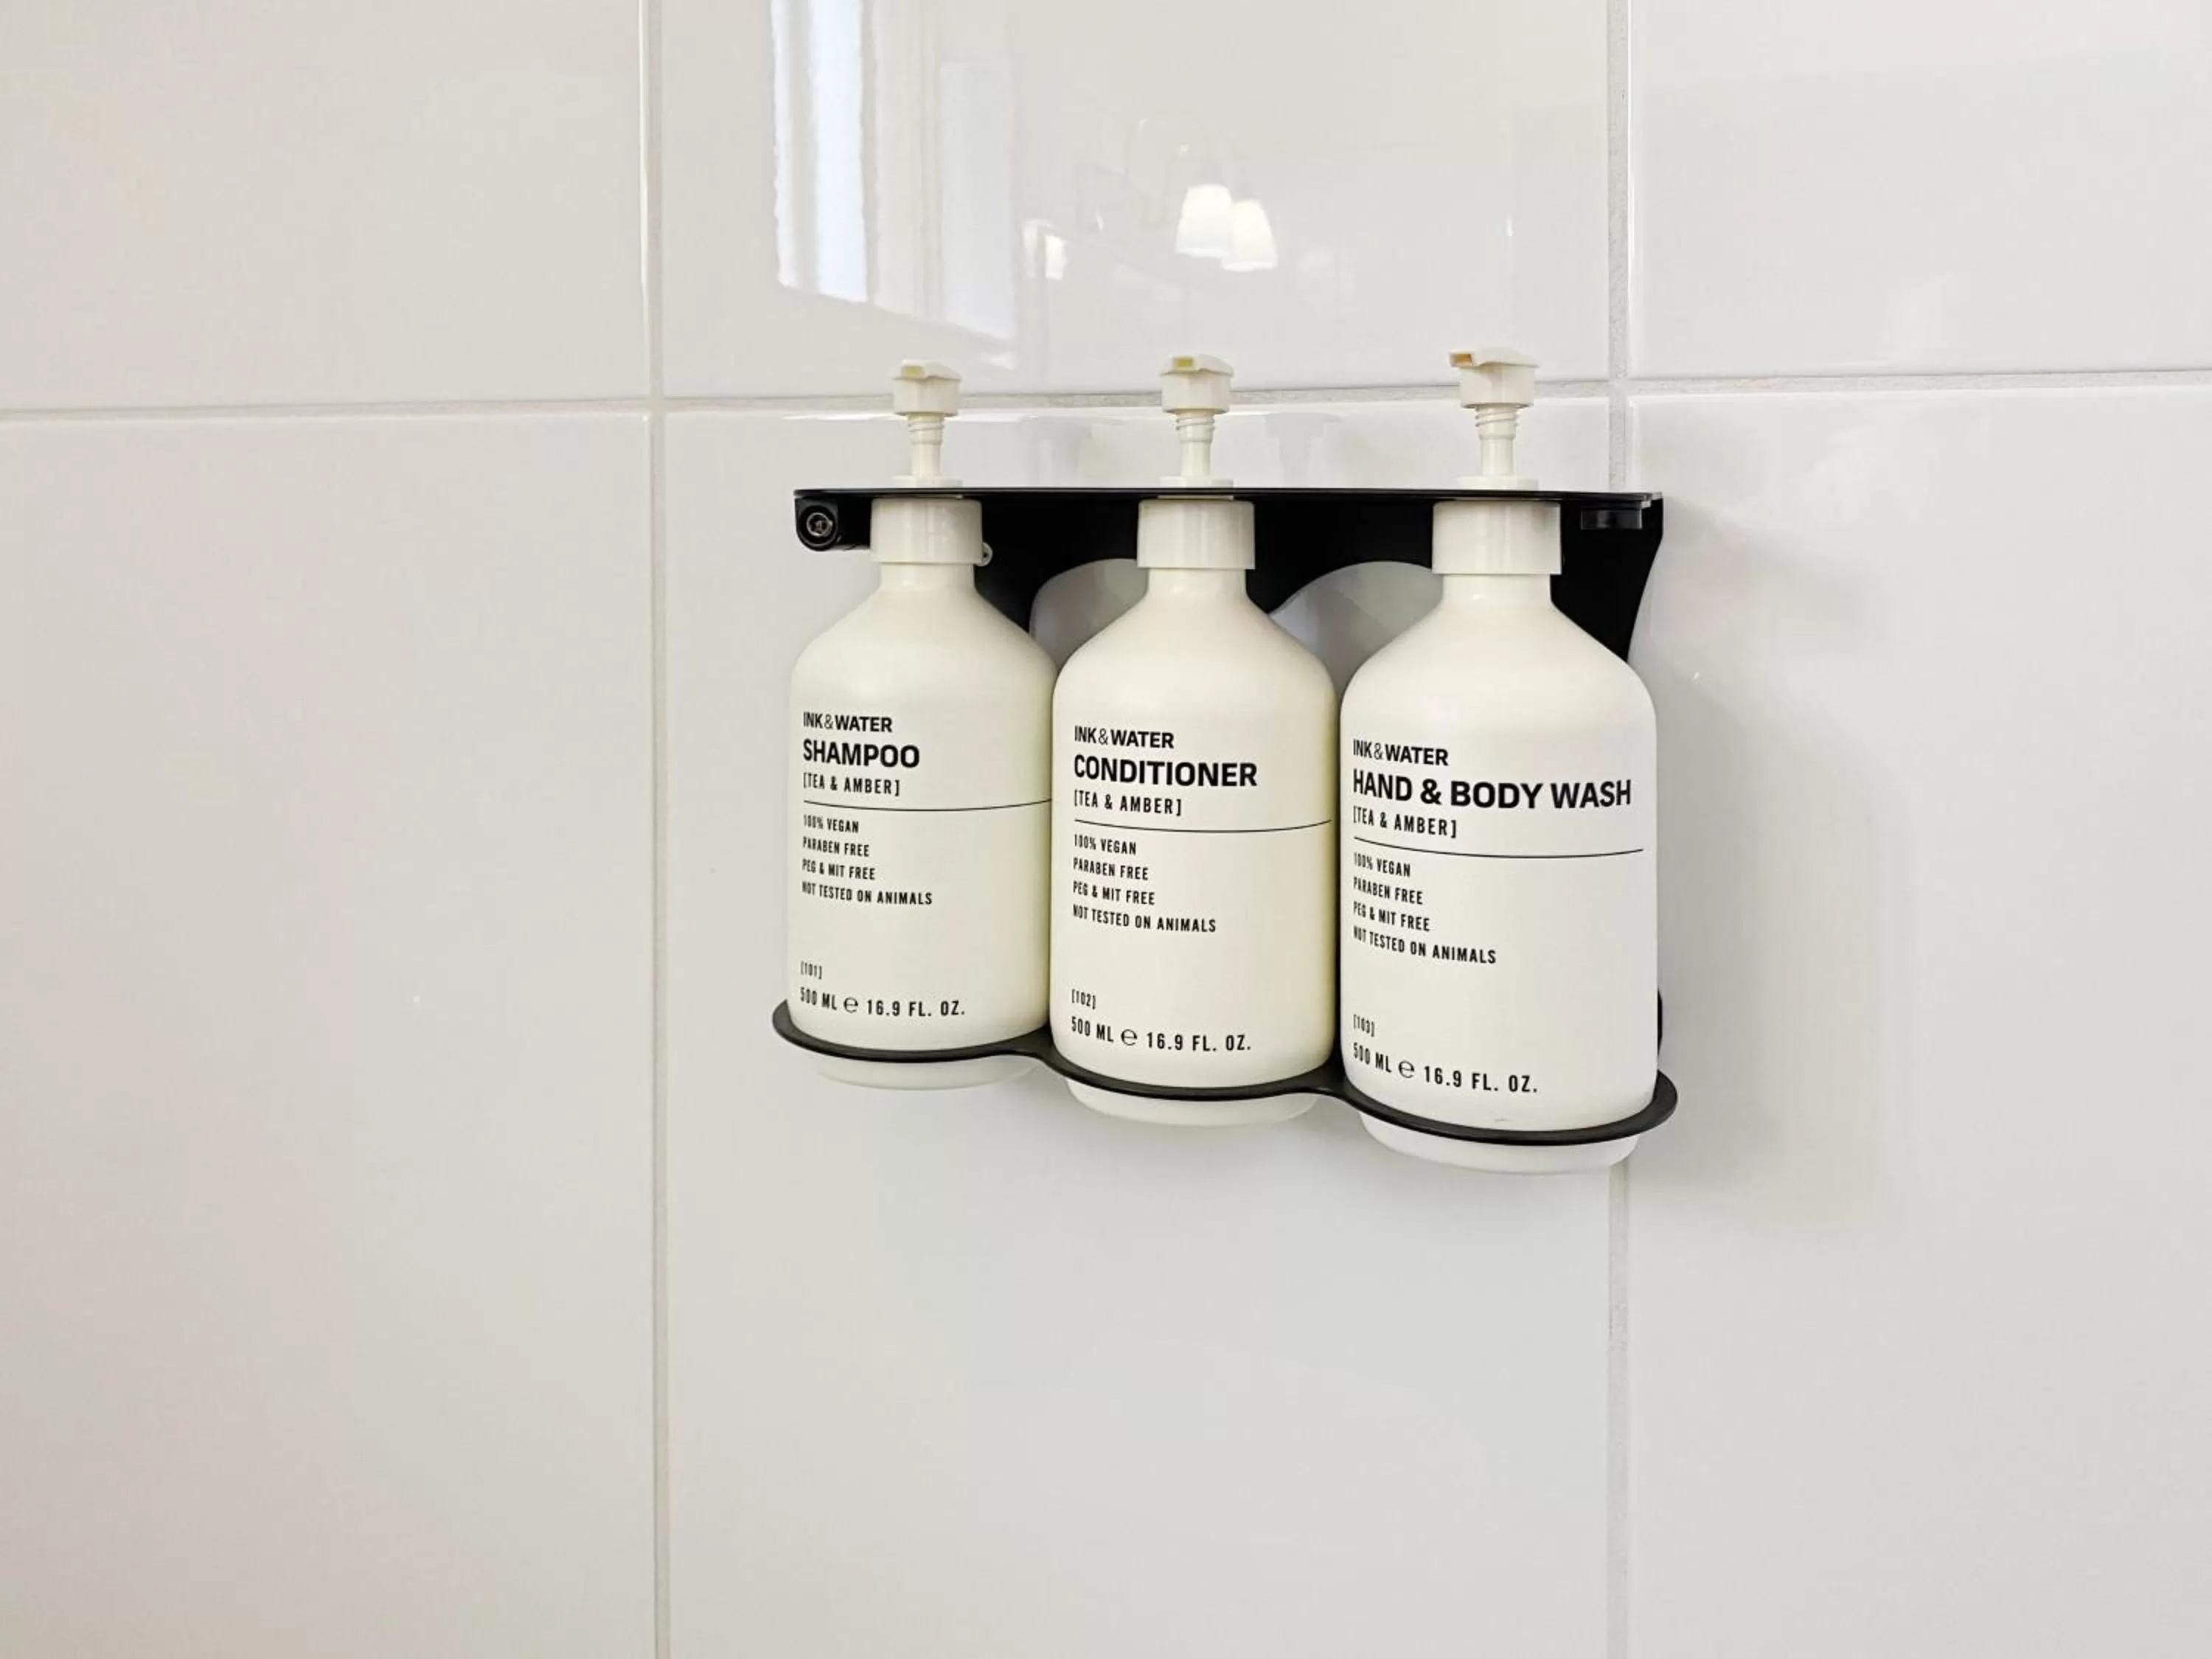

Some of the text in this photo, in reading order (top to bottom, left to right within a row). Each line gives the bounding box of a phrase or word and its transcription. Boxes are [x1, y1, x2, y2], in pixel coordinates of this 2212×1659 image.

[802, 711, 894, 734] INK&WATER
[1074, 725, 1175, 750] INK&WATER
[802, 738, 919, 768] SHAMPOO
[1352, 738, 1450, 767] INK&WATER
[1074, 754, 1258, 787] CONDITIONER
[803, 772, 901, 798] [TEA & AMBER]
[1352, 768, 1632, 810] HAND & BODY WASH
[1074, 788, 1182, 818] [TEA & AMBER]
[803, 813, 860, 834] 100% VEGAN
[1352, 804, 1457, 838] [TEA & AMBER]
[802, 835, 870, 858] PARABEN FREE
[1074, 832, 1137, 856] 100% VEGAN
[801, 858, 877, 881] PEG & MIT FREE
[1073, 857, 1150, 882] PARABEN FREE
[1353, 852, 1411, 878] 100% VEGAN
[801, 880, 933, 906] NOT TESTED ON ANIMALS
[1073, 880, 1155, 906] PEG & MIT FREE
[1353, 876, 1424, 905] PARABEN FREE
[1072, 902, 1217, 933] NOT TESTED ON ANIMALS
[1352, 900, 1431, 933] PEG & MIT FREE
[1353, 924, 1497, 965] NOT TESTED ON ANIMALS
[800, 960, 823, 980] [101]
[799, 986, 818, 1006] 500
[821, 992, 838, 1012] ML
[866, 998, 901, 1018] 16.9
[908, 1001, 933, 1018] FL.
[939, 999, 965, 1018] OZ.
[1071, 988, 1096, 1011] [102]
[1071, 1014, 1091, 1037] 500
[1095, 1023, 1115, 1044] ML
[1146, 1031, 1184, 1051] 16.9
[1192, 1034, 1217, 1053] FL.
[1225, 1033, 1251, 1052] OZ.
[1353, 1014, 1375, 1038] [103]
[1352, 1041, 1371, 1065] 500
[1374, 1051, 1393, 1074] ML
[1423, 1065, 1463, 1088] 16.9
[1471, 1071, 1499, 1092] FL.
[1508, 1074, 1538, 1093] OZ.
